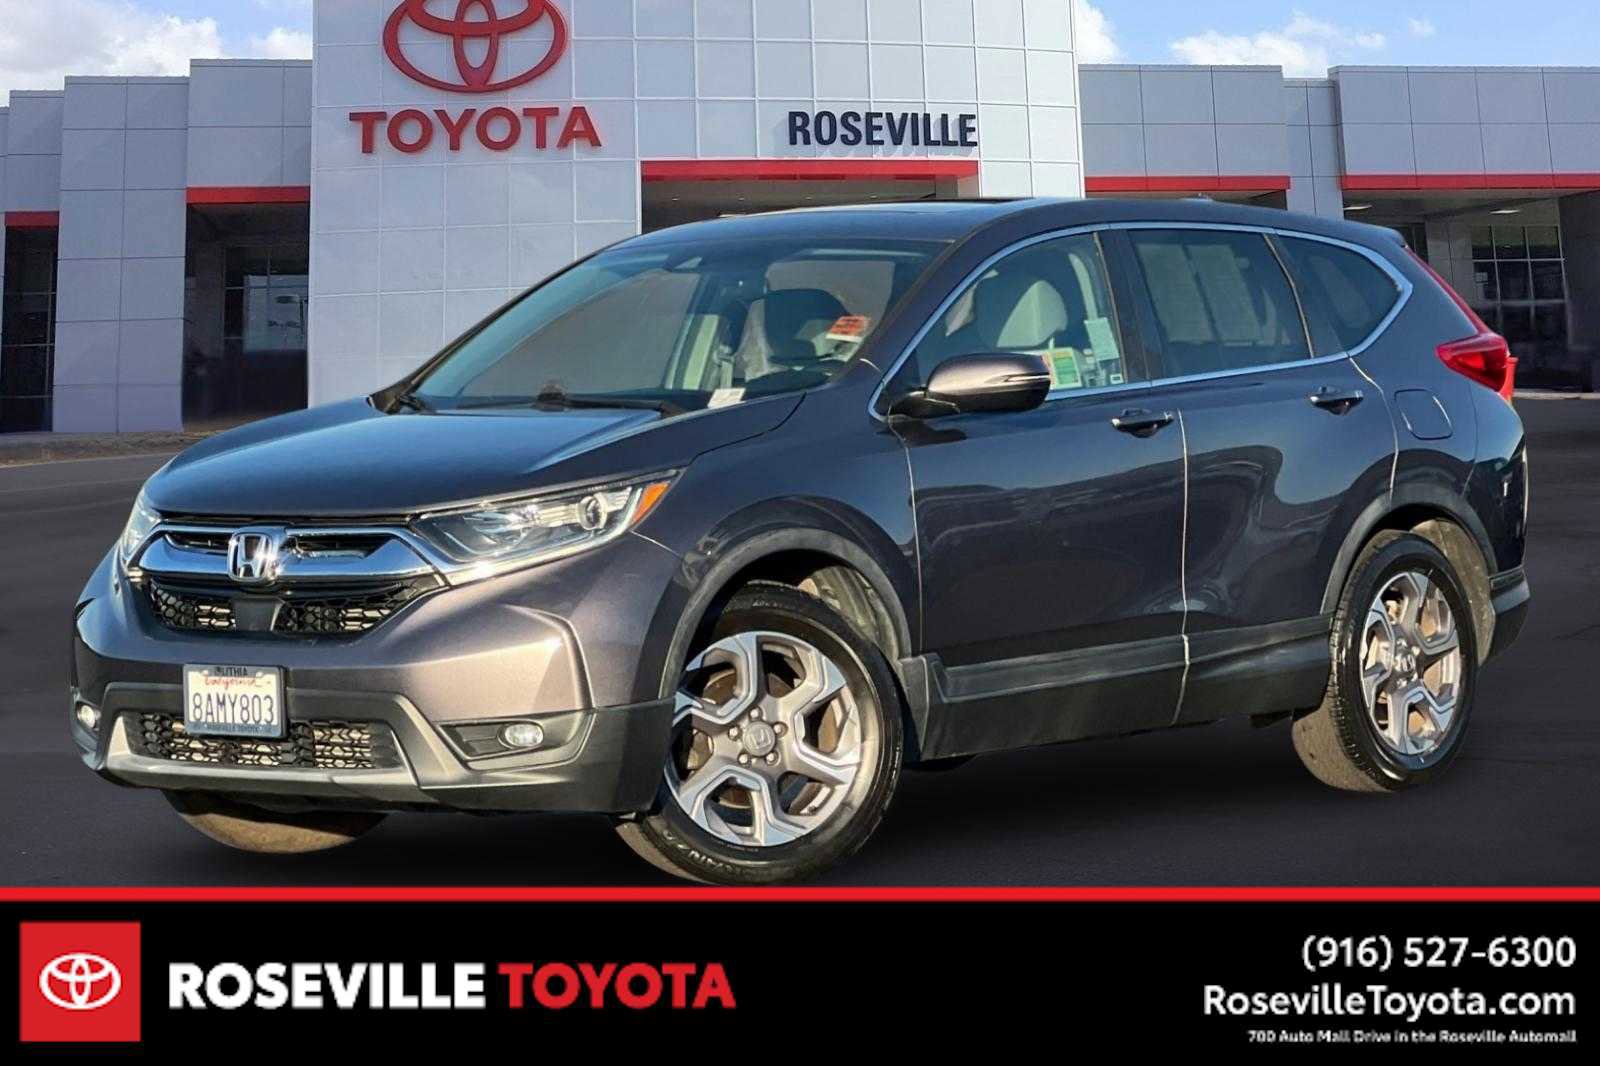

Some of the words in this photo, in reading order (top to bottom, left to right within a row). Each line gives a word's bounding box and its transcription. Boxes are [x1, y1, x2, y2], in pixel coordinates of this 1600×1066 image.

[349, 106, 602, 154] TOYOTA
[788, 111, 978, 147] ROSEVILLE
[192, 692, 275, 724] 8AMY803
